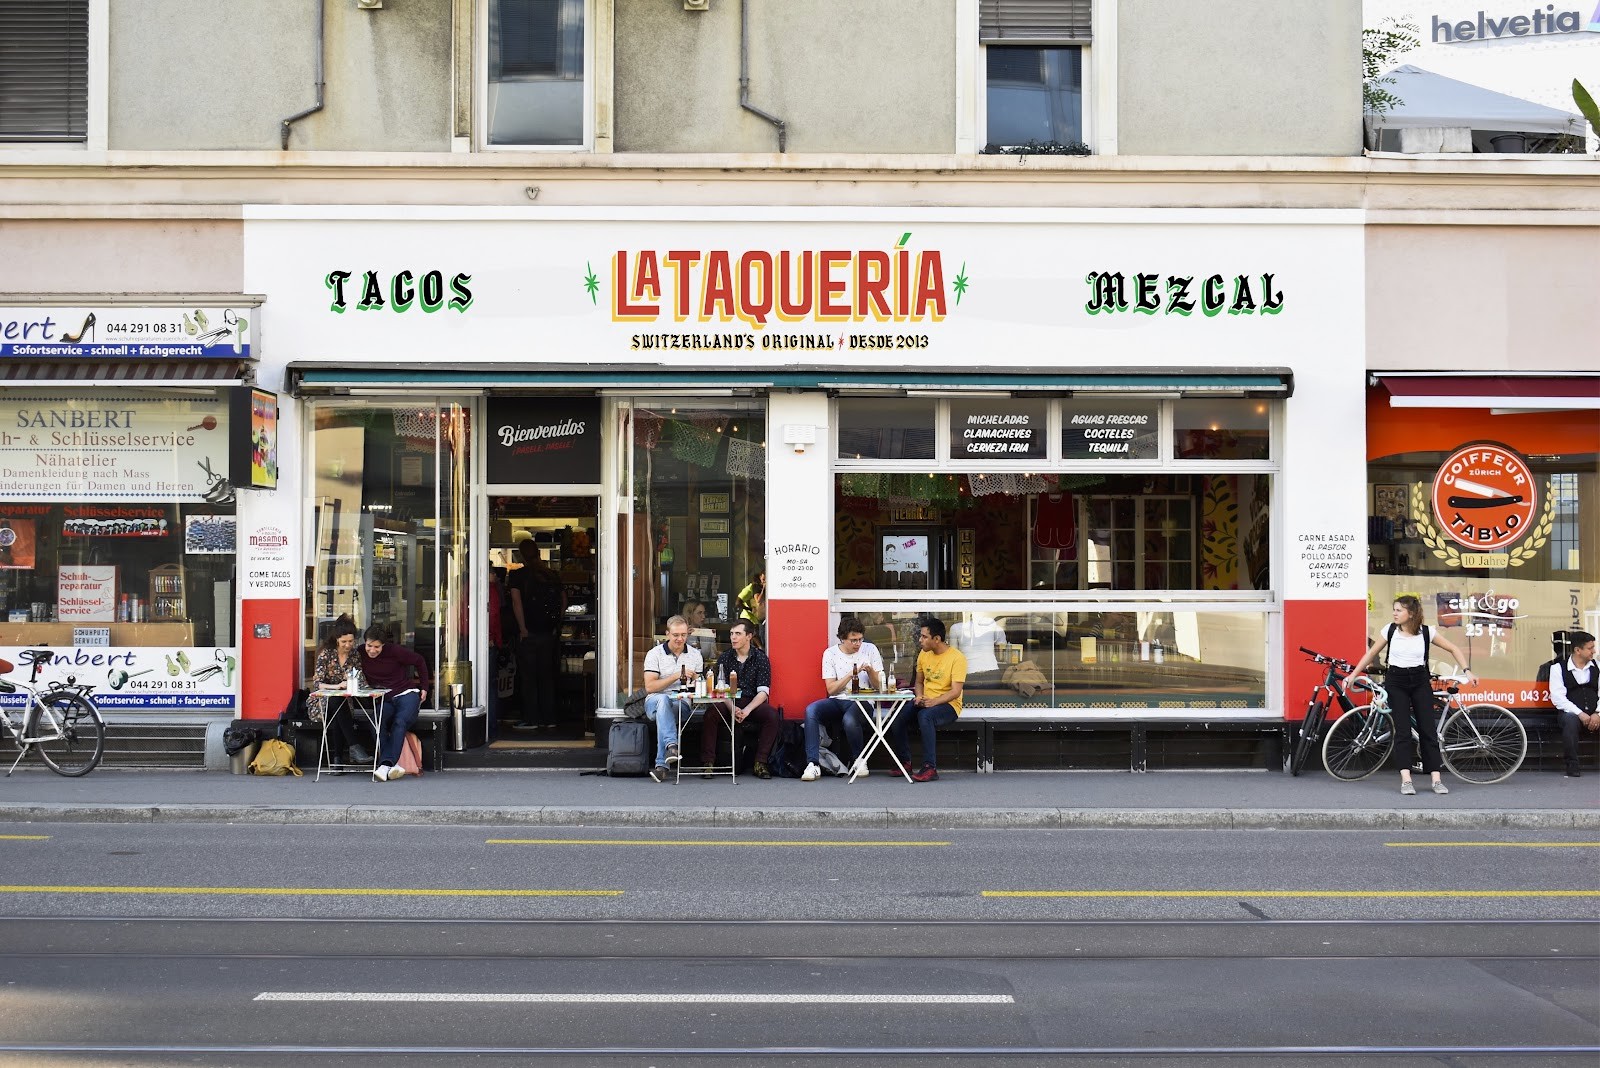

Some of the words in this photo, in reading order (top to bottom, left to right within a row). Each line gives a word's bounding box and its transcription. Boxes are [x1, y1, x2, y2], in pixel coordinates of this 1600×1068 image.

[1431, 4, 1580, 43] helvetia
[611, 250, 661, 322] LA
[662, 232, 947, 330] TAQUERÍA
[325, 270, 474, 314] TACOS
[1085, 271, 1284, 317] MEZCAL
[0, 316, 56, 340] ert
[107, 323, 127, 333] 044
[130, 323, 149, 333] 291
[153, 323, 167, 333] 08
[170, 323, 182, 333] 31
[630, 334, 755, 351] SWITZERLAND'S
[762, 334, 835, 351] ORIGINAL
[849, 335, 894, 351] DESDE
[896, 335, 930, 351] 2013
[13, 345, 82, 355] Sofortservice
[91, 345, 127, 355] schnell
[140, 345, 202, 357] fachgerecht
[17, 410, 136, 428] SANBERT
[967, 414, 1029, 425] MICHELADAS
[1071, 414, 1104, 425] AGUAS
[1106, 414, 1148, 425] FRESCAS
[497, 418, 586, 447] Bienvenidos
[963, 429, 1032, 439] CLAMACHEVES
[1084, 429, 1135, 439] COCTELES
[29, 435, 39, 445] &
[51, 432, 195, 446] Schlüsselservice
[967, 443, 1008, 453] CERVEZA
[1009, 443, 1029, 453] FRIA
[1088, 443, 1129, 453] TEQUILA
[36, 454, 117, 467] Nähatelier
[3, 468, 87, 479] Damenkleidung
[93, 468, 118, 478] nach
[123, 469, 150, 478] Mass
[1443, 452, 1526, 487] COIFFEUR
[1469, 468, 1502, 476] ZÜRICH
[67, 482, 81, 490] für
[88, 482, 126, 490] Damen
[131, 482, 151, 490] und
[157, 482, 194, 491] Herren
[64, 505, 165, 517] Schlüsselservice
[1451, 513, 1522, 542] TABLO
[1298, 534, 1326, 542] CARNE
[1328, 534, 1355, 542] ASADA
[774, 544, 820, 555] HORARIO
[1308, 562, 1349, 570] CARNITAS
[1464, 555, 1475, 566] 10
[1477, 555, 1506, 566] Jahre
[60, 572, 91, 581] Schuh-
[60, 582, 103, 592] reparatur
[60, 597, 104, 606] Schlüssel-
[60, 606, 91, 615] service
[1465, 624, 1484, 636] 25
[1488, 624, 1506, 636] Fr.
[18, 648, 137, 667] Snbert
[130, 680, 148, 689] 044
[151, 680, 168, 689] 291
[171, 680, 183, 689] 08
[185, 680, 196, 689] 31
[94, 696, 144, 705] Sofortservice
[150, 696, 176, 705] schnell
[184, 696, 230, 707] fachgerecht
[1520, 690, 1540, 702] 043
